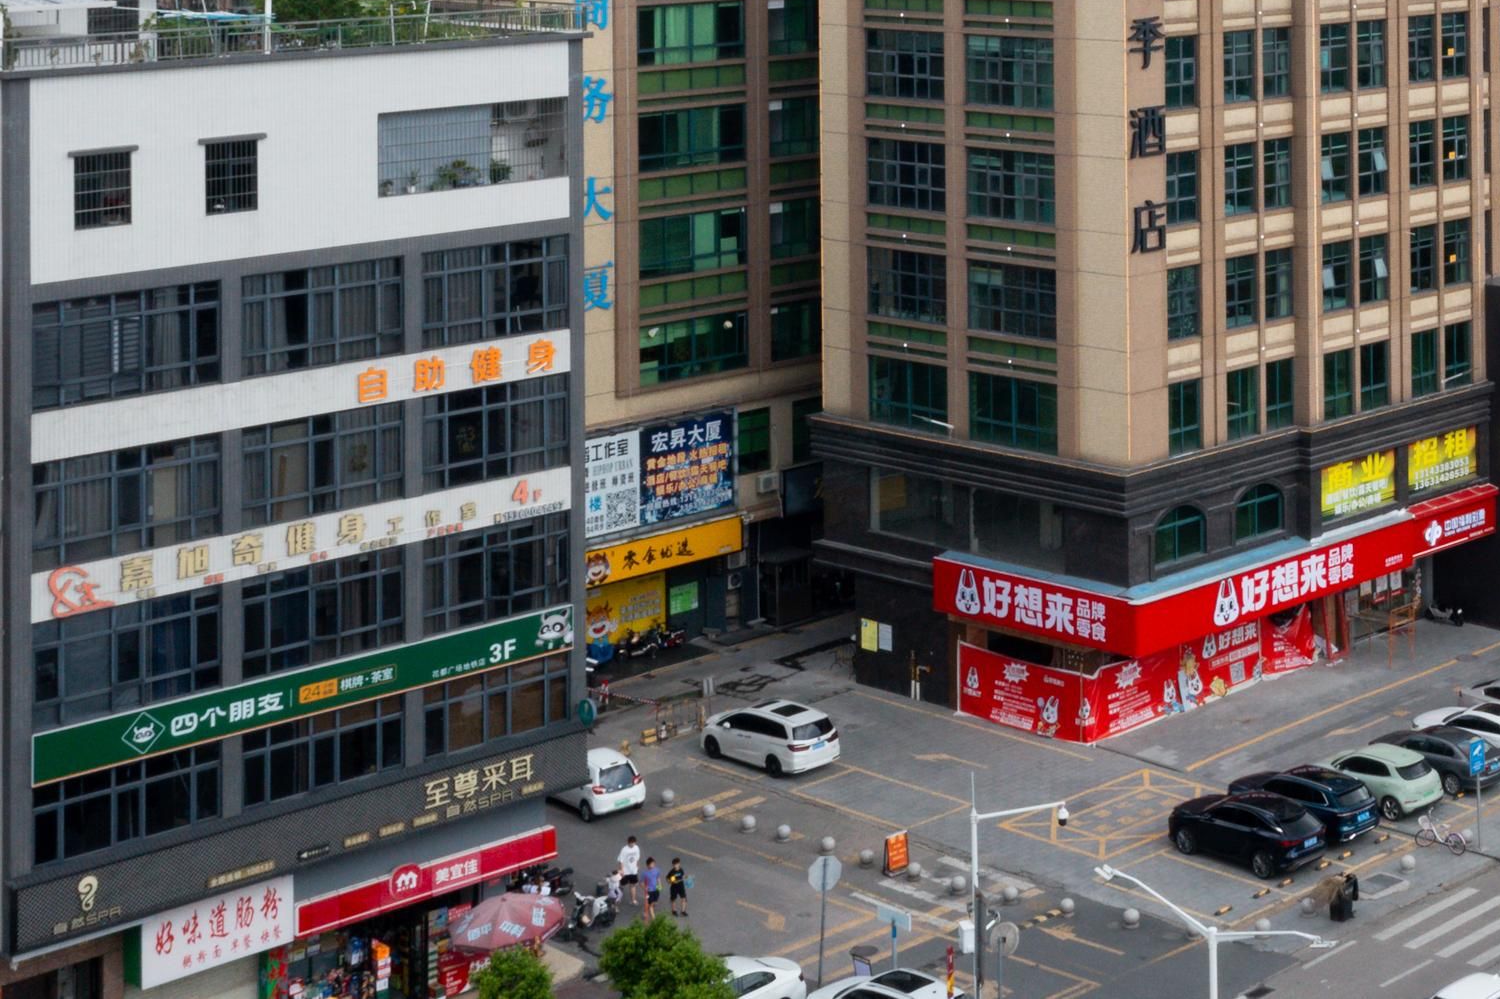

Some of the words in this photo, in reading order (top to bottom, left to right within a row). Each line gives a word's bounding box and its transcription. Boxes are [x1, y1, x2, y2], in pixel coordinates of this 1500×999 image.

[358, 338, 556, 403] 自助健身
[651, 420, 722, 453] 宏昇大厦
[1413, 429, 1469, 467] 招租
[1328, 452, 1386, 492] 商业
[120, 502, 477, 593] 嘉旭奇健身工作室
[1328, 543, 1354, 566] 品牌
[1241, 554, 1328, 616] 好想来
[1328, 563, 1354, 586] 零食
[982, 576, 1075, 636] 好想来
[1077, 597, 1106, 622] 品牌
[1077, 617, 1106, 643] 零食
[1218, 622, 1258, 651] 好想来
[489, 638, 517, 664] 3F
[171, 692, 284, 738] 四个朋友
[424, 754, 534, 810] 至尊采耳
[435, 858, 479, 884] 美宜佳
[155, 886, 282, 956] 好味道肠粉
